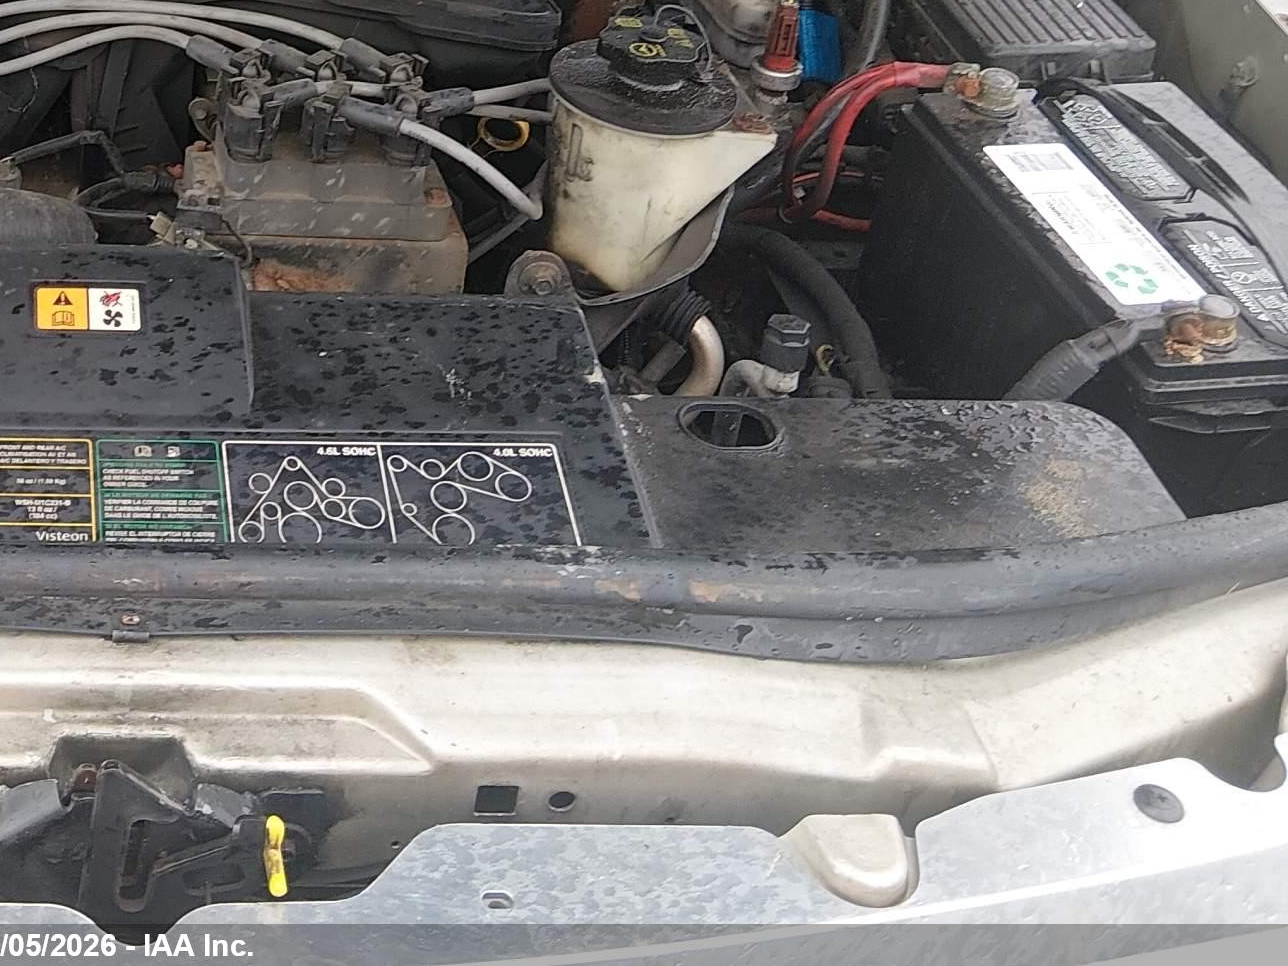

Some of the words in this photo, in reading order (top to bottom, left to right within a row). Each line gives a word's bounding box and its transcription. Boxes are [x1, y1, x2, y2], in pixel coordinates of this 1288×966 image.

[342, 446, 376, 456] SOHC
[518, 448, 552, 458] SOHC
[35, 530, 89, 542] Visteon
